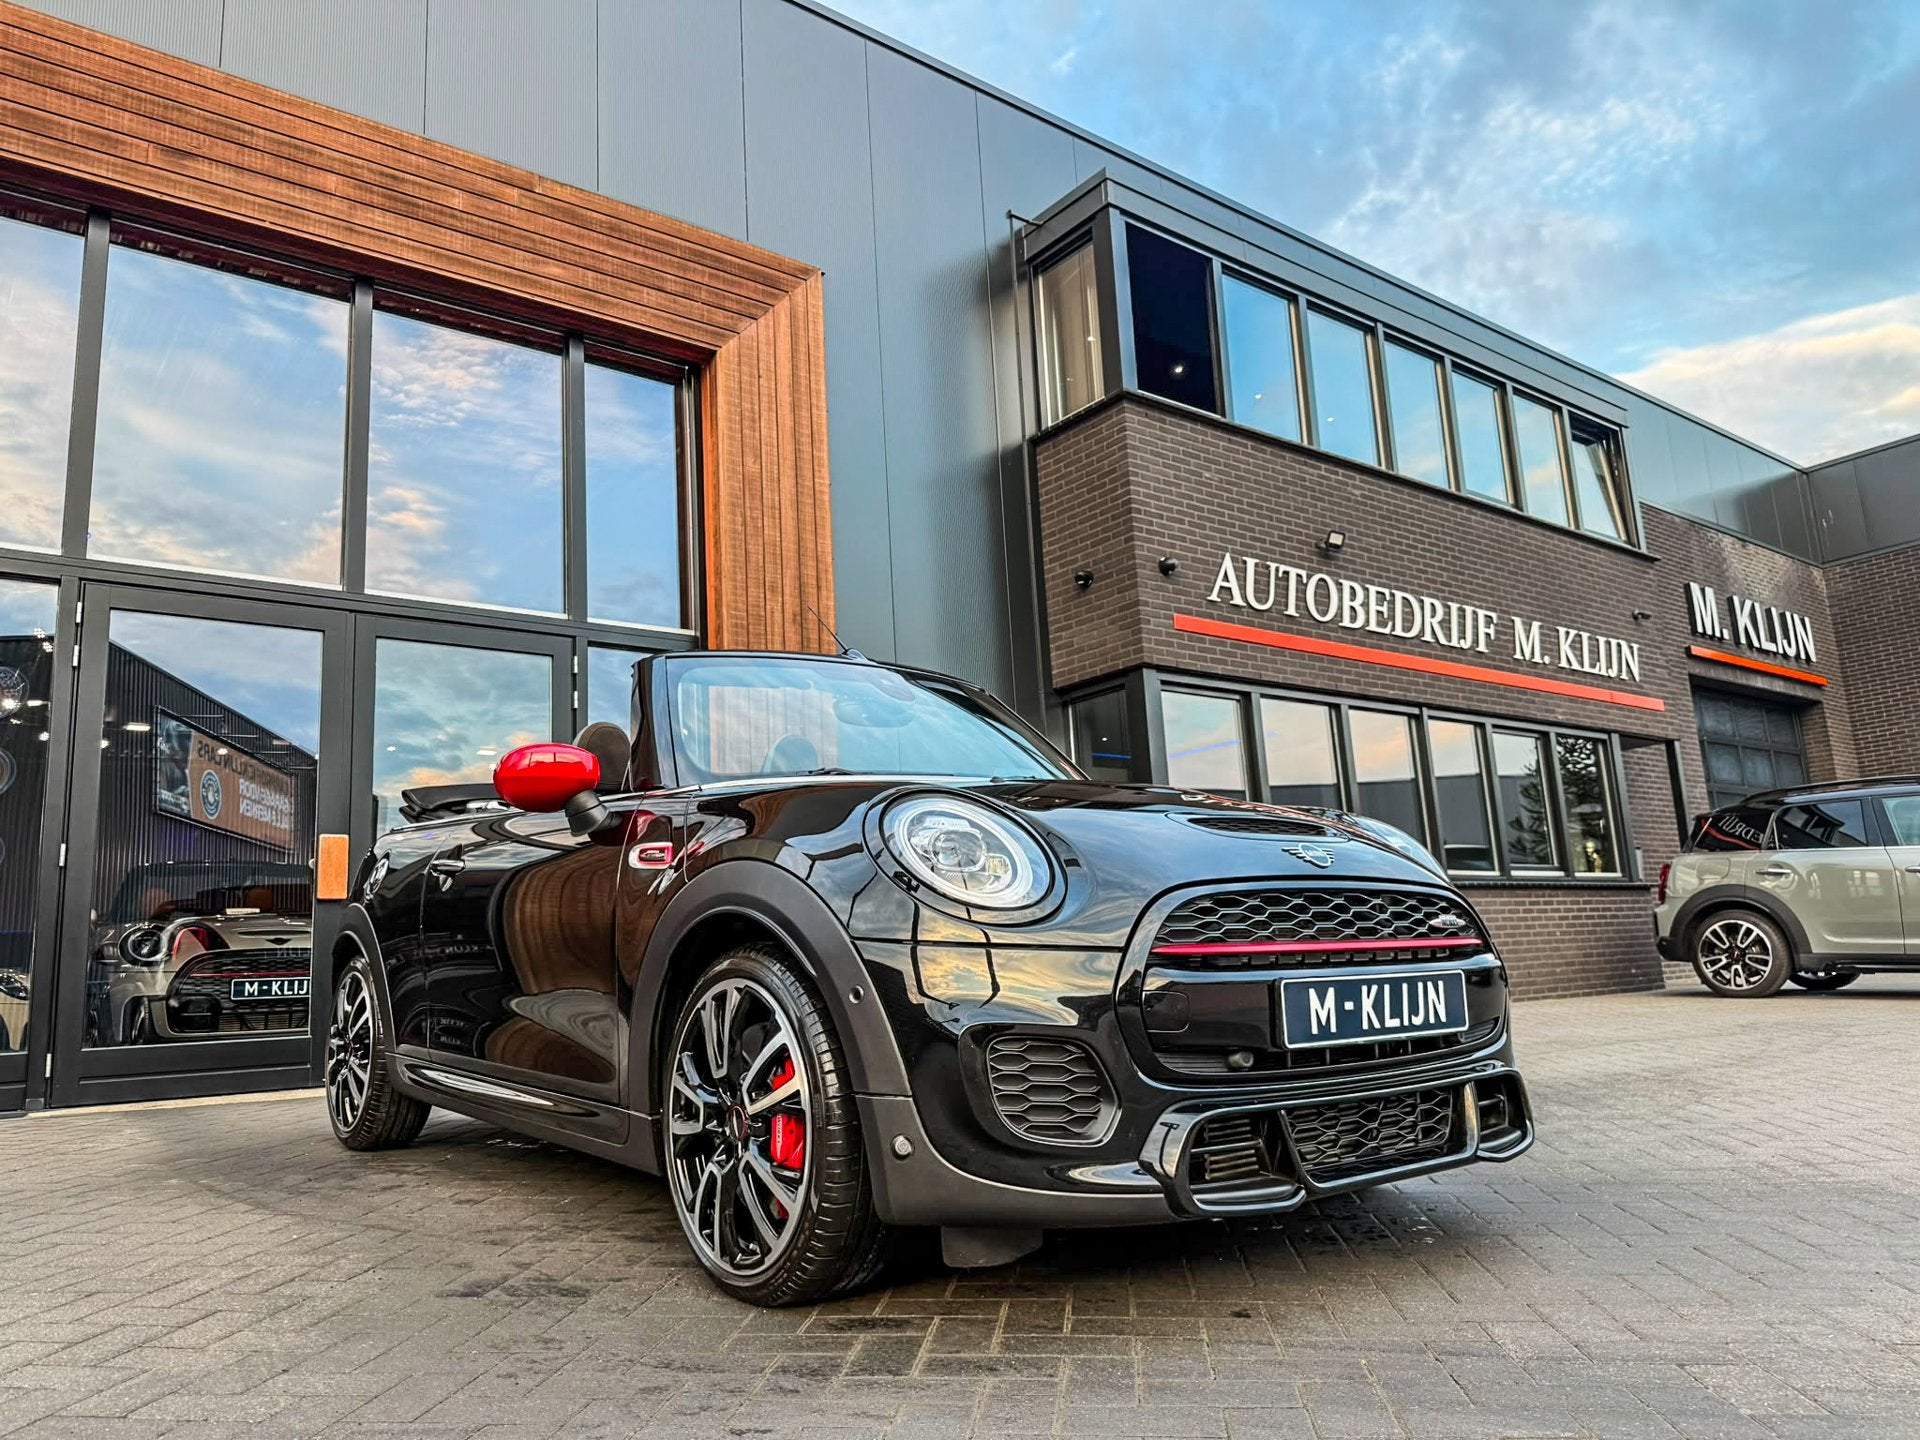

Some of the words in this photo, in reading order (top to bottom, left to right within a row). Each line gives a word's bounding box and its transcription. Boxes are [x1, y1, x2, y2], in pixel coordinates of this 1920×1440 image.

[1207, 552, 1498, 653] AUTOBEDRIJF
[1511, 616, 1550, 664] M.
[1556, 626, 1640, 682] KLIJN
[1687, 581, 1729, 640] M.
[1730, 595, 1817, 663] KLIJN
[244, 980, 308, 997] M-KLIJ
